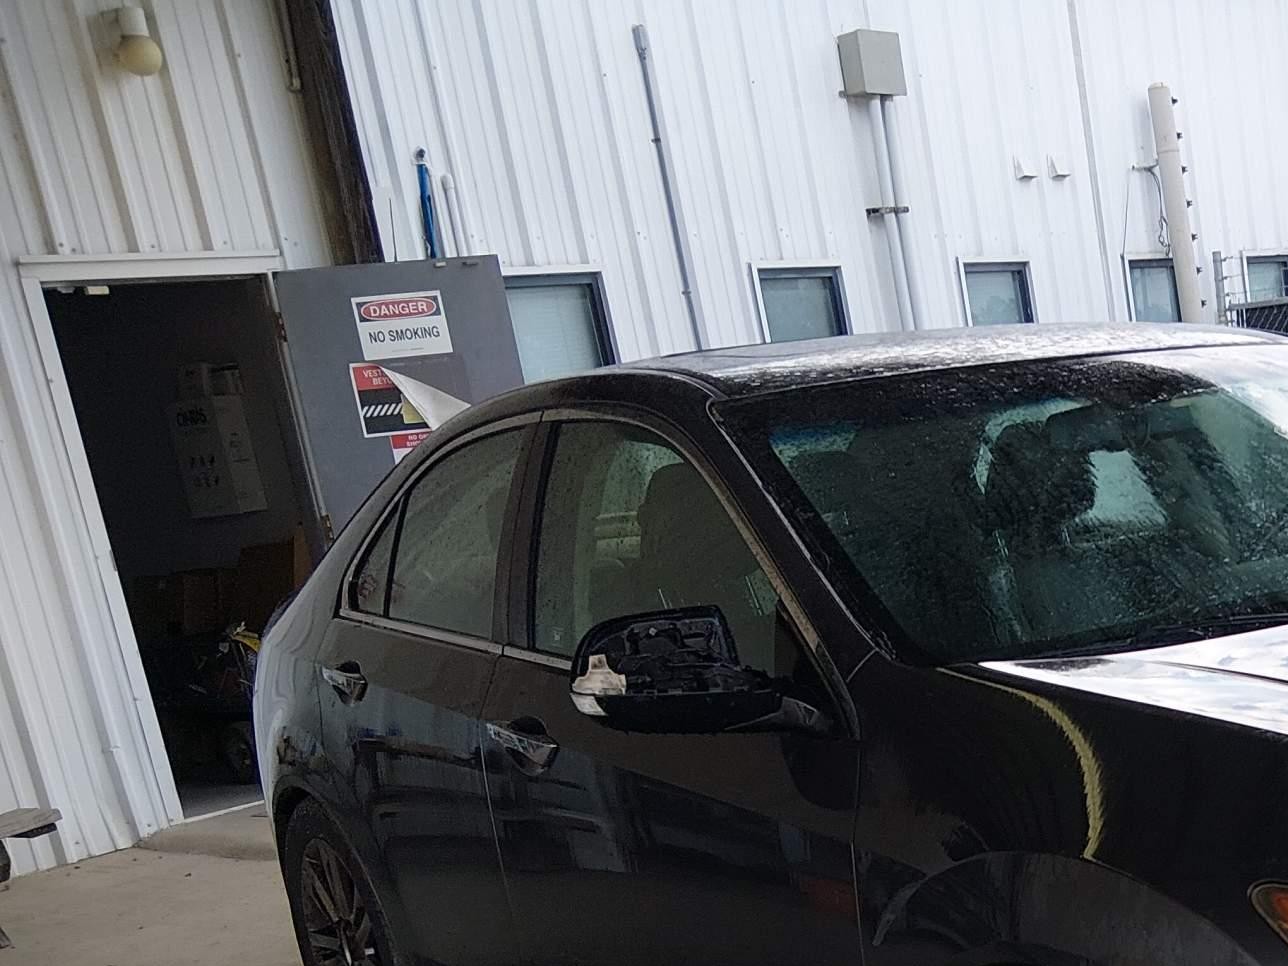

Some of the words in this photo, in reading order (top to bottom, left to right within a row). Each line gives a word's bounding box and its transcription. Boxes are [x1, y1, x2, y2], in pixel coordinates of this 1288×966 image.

[369, 301, 428, 317] DANGER
[368, 331, 386, 344] NO
[389, 326, 441, 342] SMOKING
